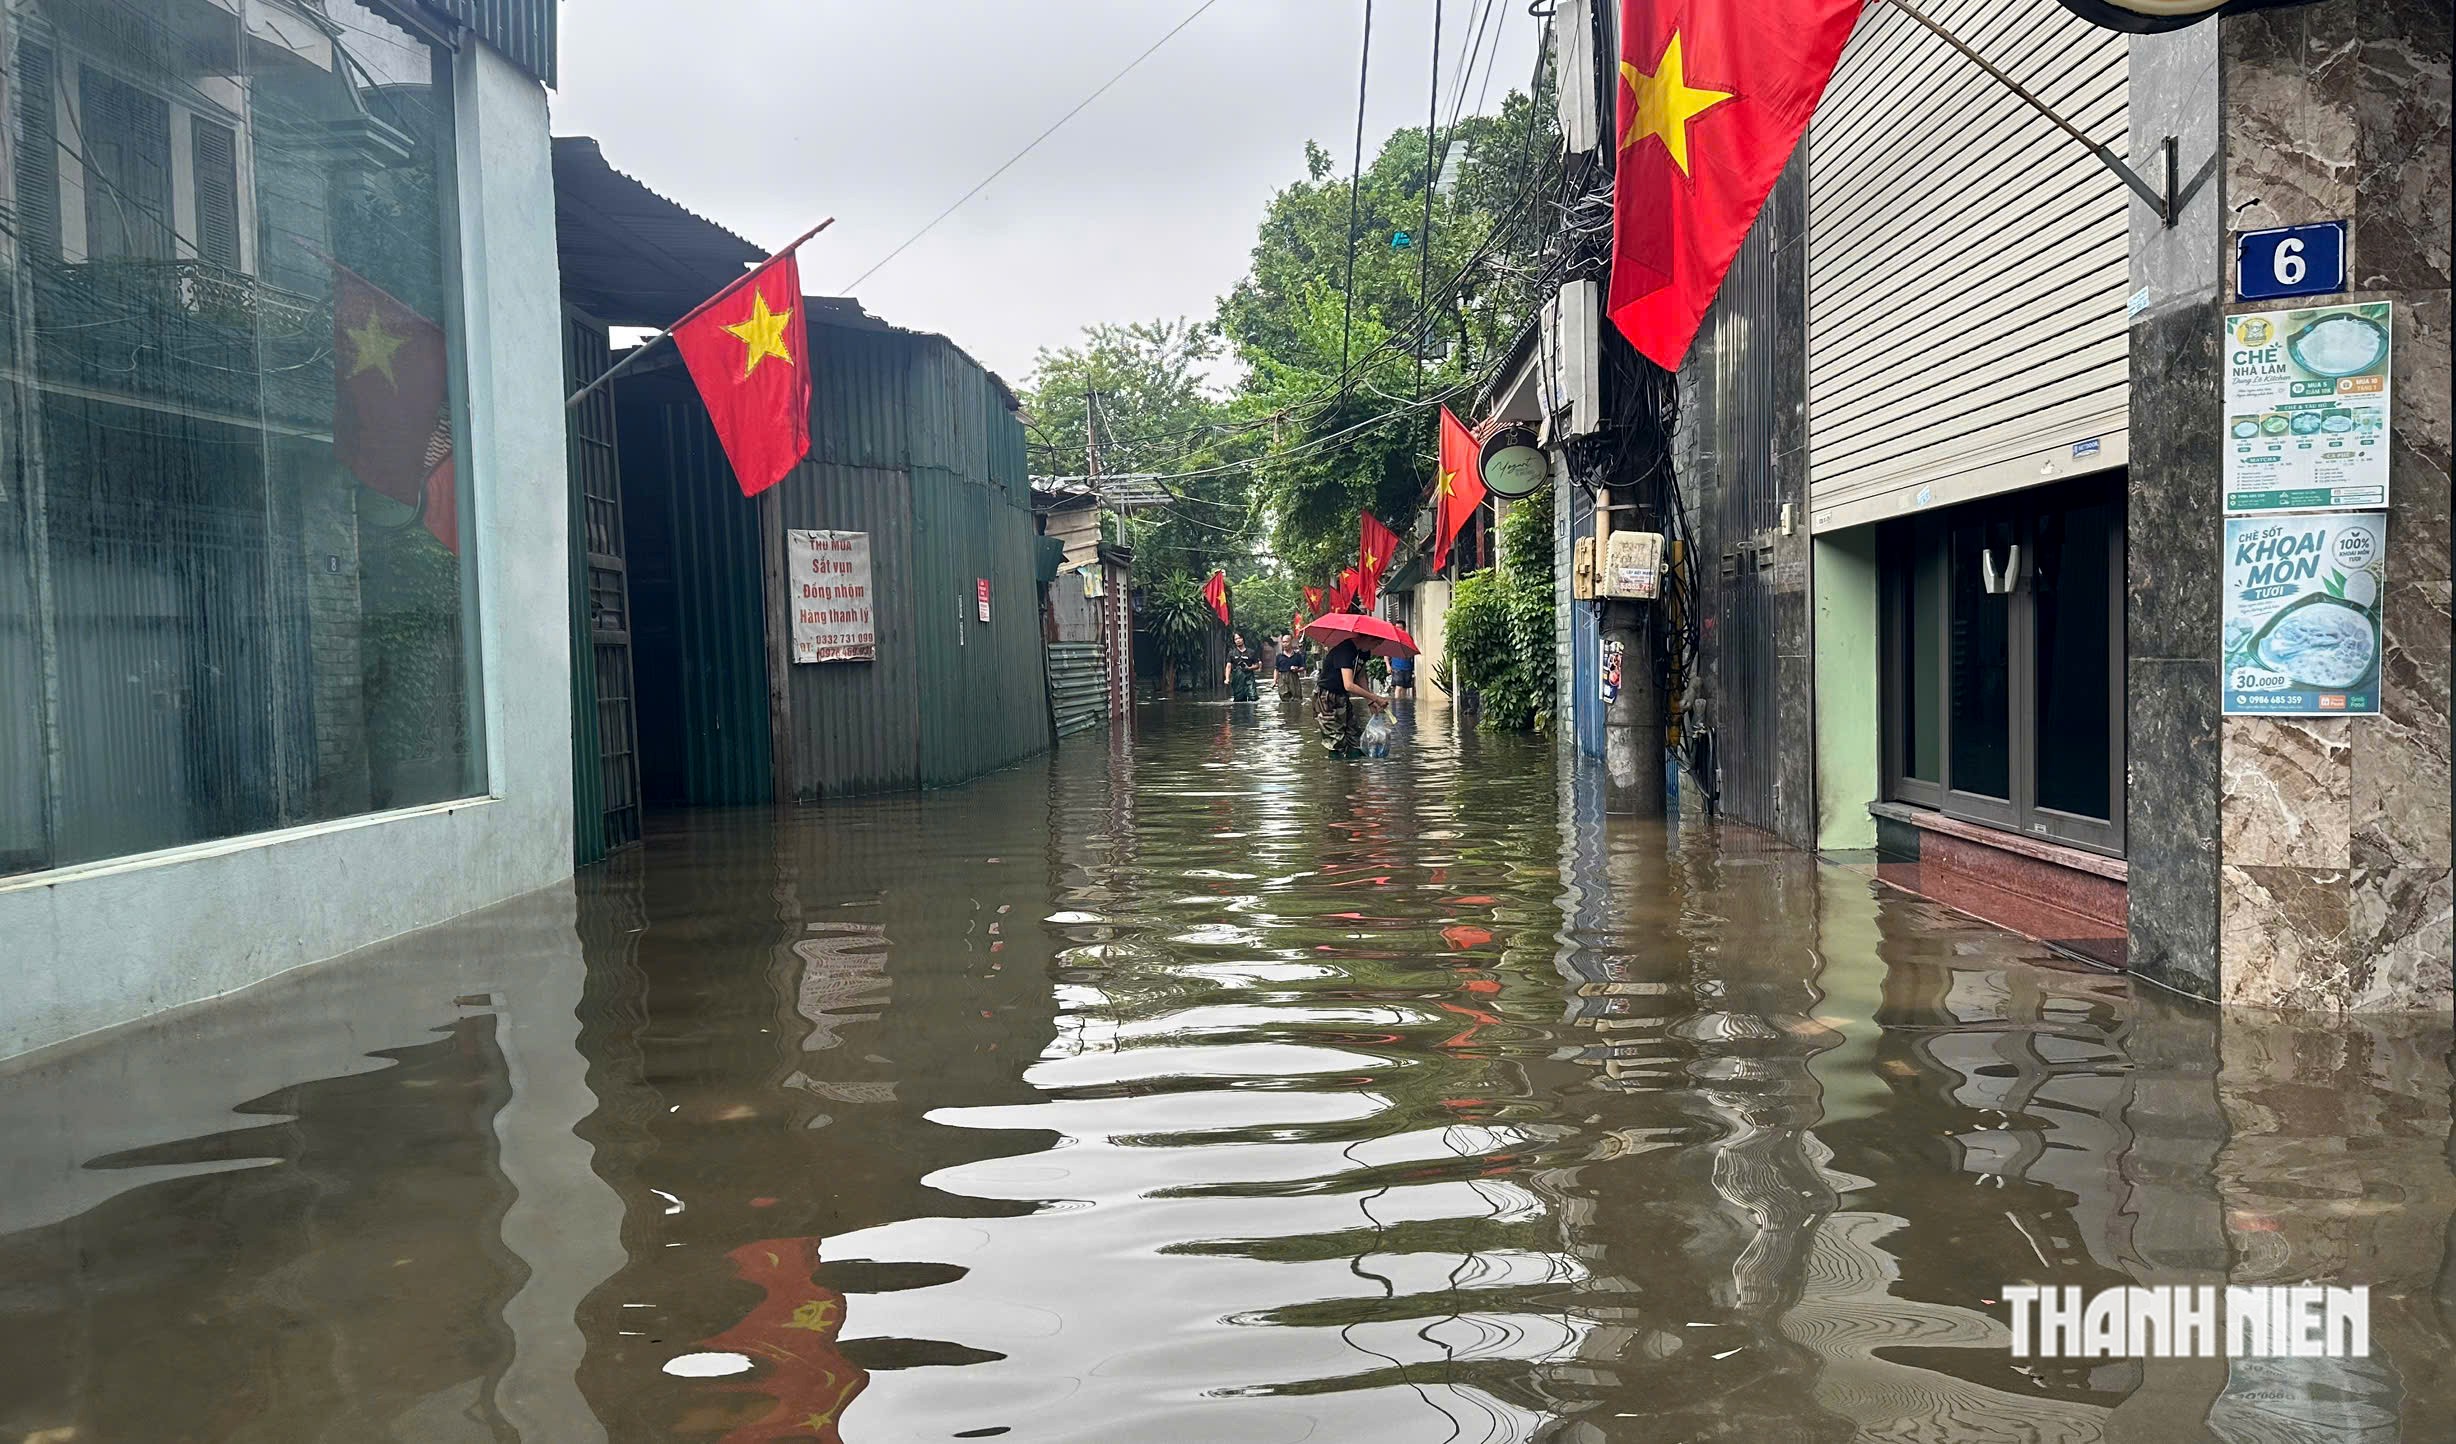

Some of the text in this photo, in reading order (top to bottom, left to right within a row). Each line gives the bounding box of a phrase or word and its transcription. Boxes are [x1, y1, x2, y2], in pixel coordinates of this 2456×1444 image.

[2274, 238, 2306, 284] 6
[2232, 344, 2278, 365] CHÈ
[2232, 363, 2286, 376] NHÀ LÀM
[2239, 525, 2283, 543] CHÈ SỐT
[810, 540, 852, 551] THU MUA
[2235, 530, 2326, 566] KHOAI
[2340, 538, 2369, 550] 100%
[813, 556, 852, 577] Sắt vụn
[2247, 554, 2320, 588] MÔN
[834, 584, 864, 598] nhôm
[2255, 585, 2284, 599] TƯƠI
[800, 608, 869, 625] Hàng thanh lý
[816, 633, 873, 645] 0332 731 099
[2236, 675, 2285, 688] 30.000Đ
[2249, 695, 2302, 704] 0986 685 359
